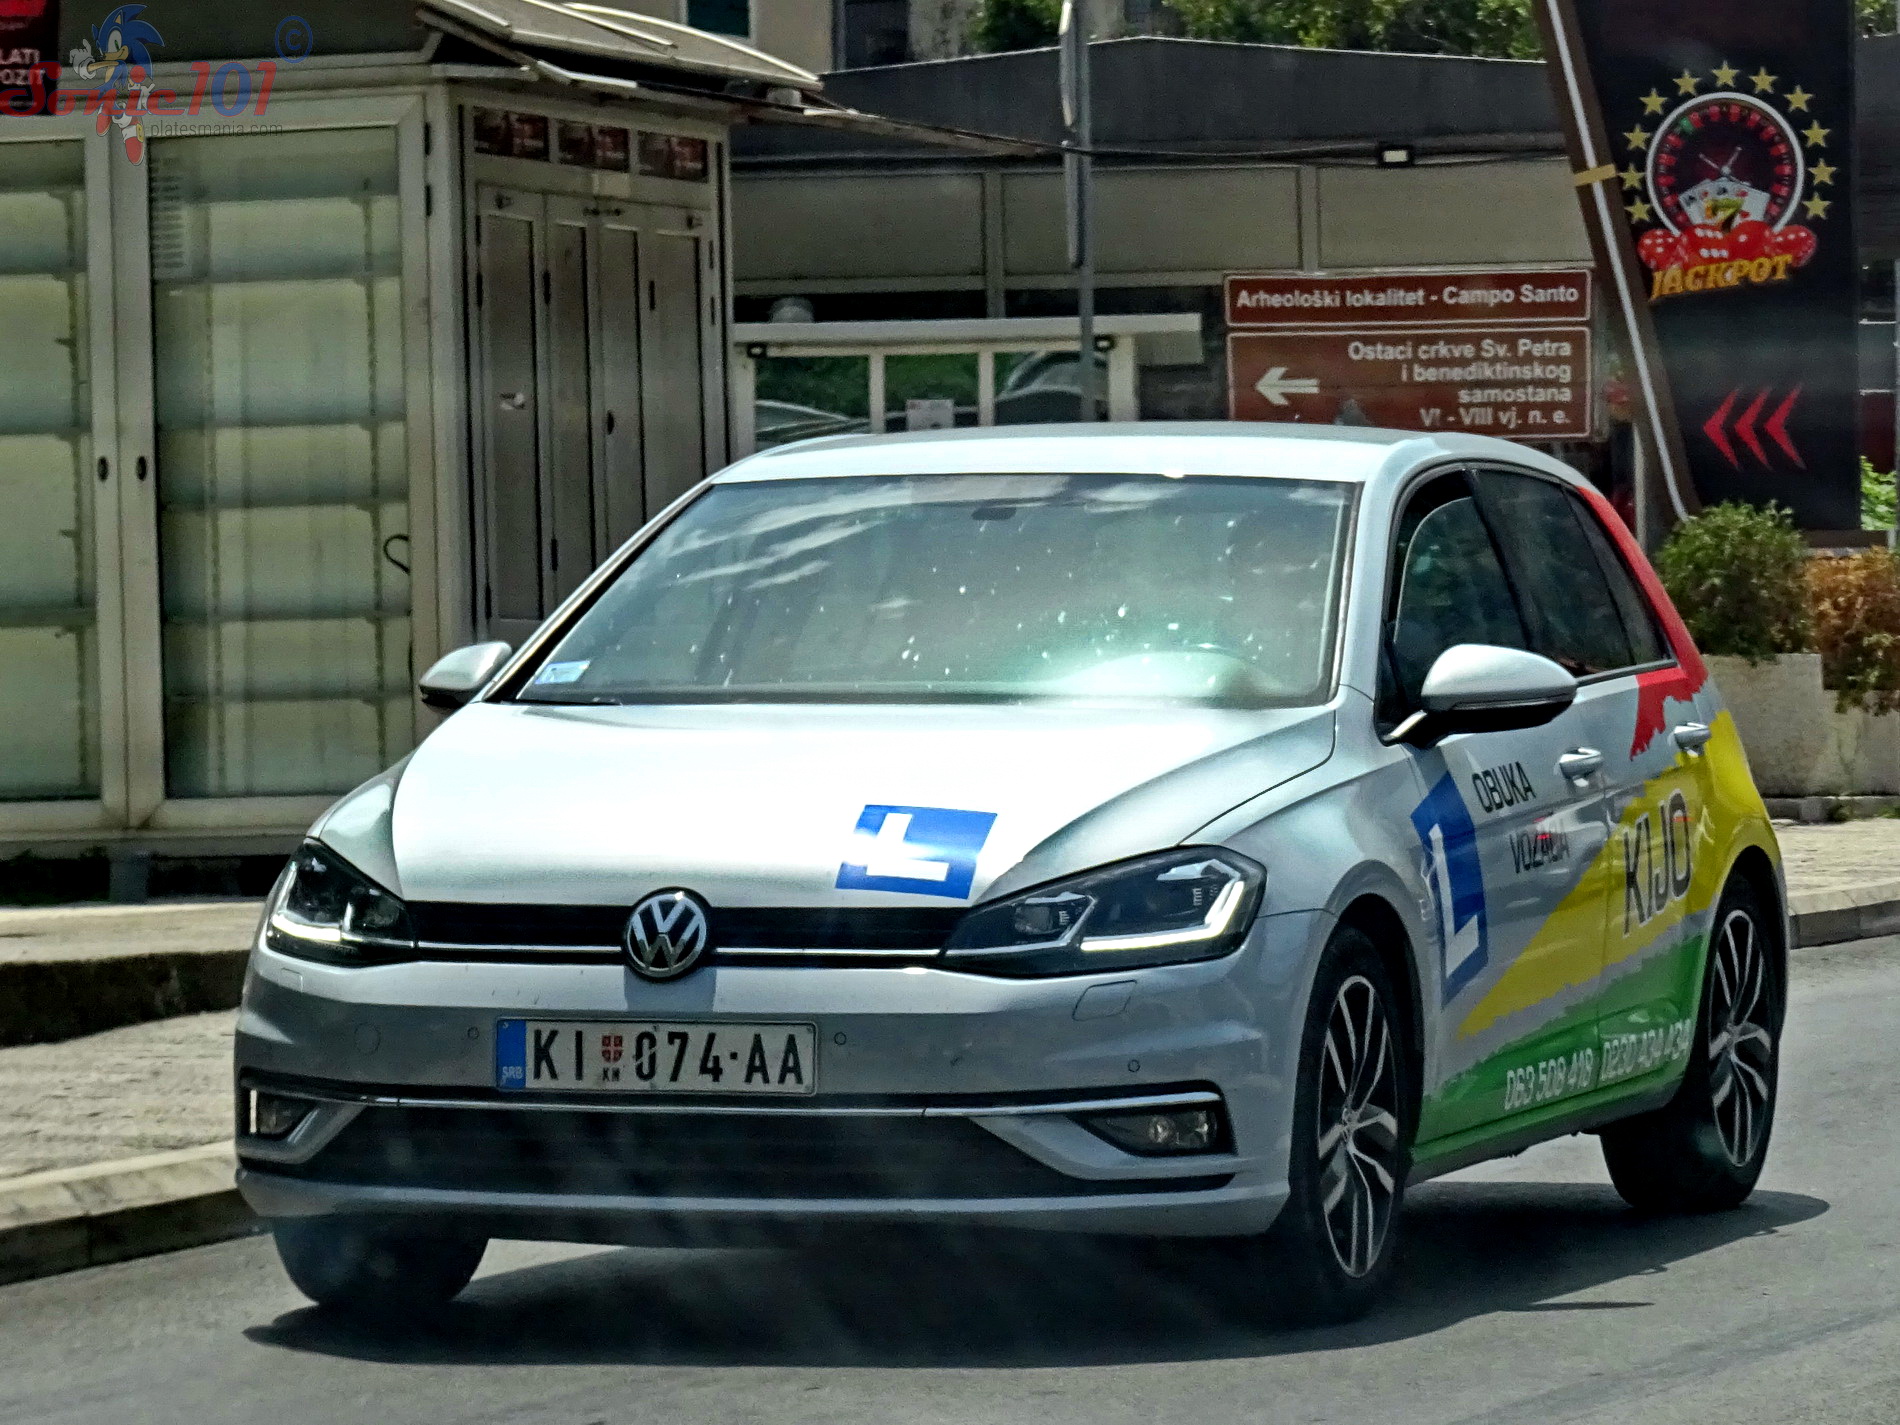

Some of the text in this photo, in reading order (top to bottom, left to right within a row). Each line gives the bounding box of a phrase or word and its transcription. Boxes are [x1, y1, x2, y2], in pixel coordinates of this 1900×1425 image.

[1650, 254, 1794, 301] JACKPOT
[1236, 288, 1341, 308] Arheološki
[1346, 287, 1426, 307] lokalitet
[1443, 286, 1515, 307] Campo
[1520, 284, 1579, 304] Santo
[1348, 338, 1572, 360] Ostaci crkve Sv. Petra
[1402, 361, 1572, 384] i benediktinskog
[1458, 385, 1572, 403] samostana
[1499, 406, 1523, 429] vj.
[1528, 409, 1548, 424] n.
[1552, 409, 1571, 424] e.
[1472, 761, 1537, 813] OBUKA
[1622, 789, 1693, 938] KIJO
[533, 1030, 584, 1081] KI
